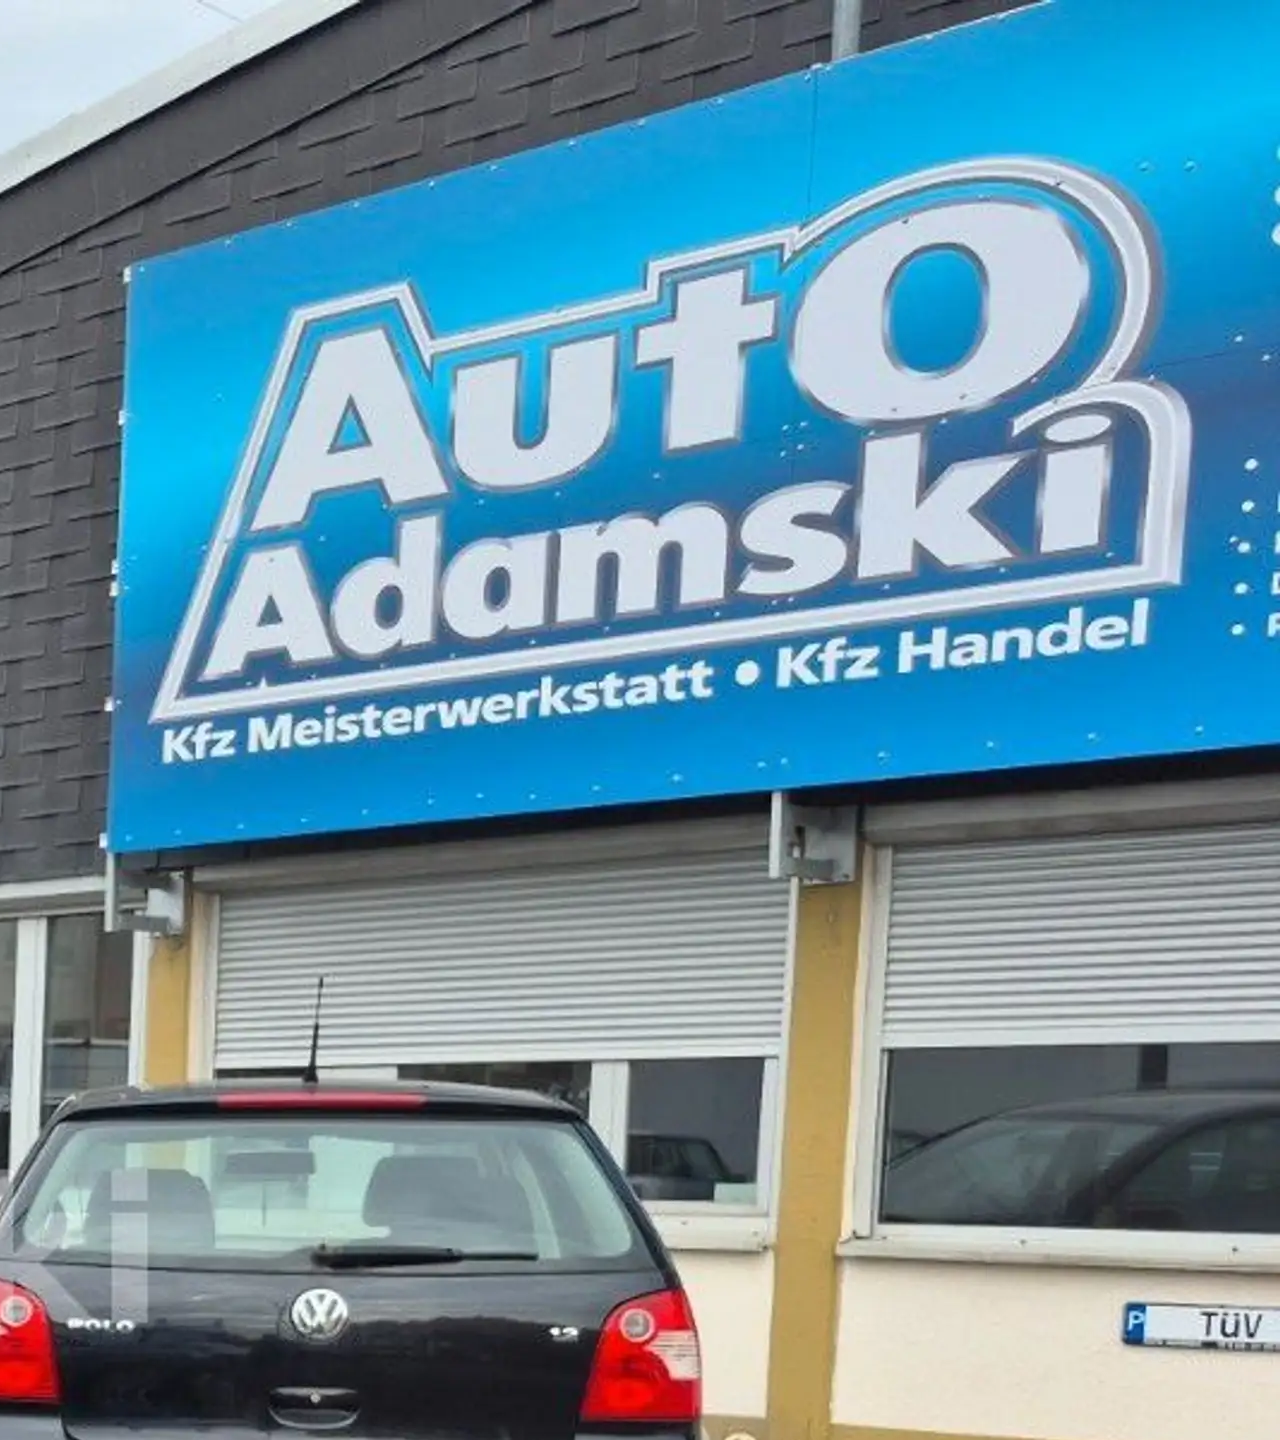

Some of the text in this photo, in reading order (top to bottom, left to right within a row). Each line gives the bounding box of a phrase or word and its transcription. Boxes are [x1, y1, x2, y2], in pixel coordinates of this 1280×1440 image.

[197, 408, 1114, 682] Adamski
[161, 597, 1151, 765] Kfz Meisterwerkstatt Kfz Handel
